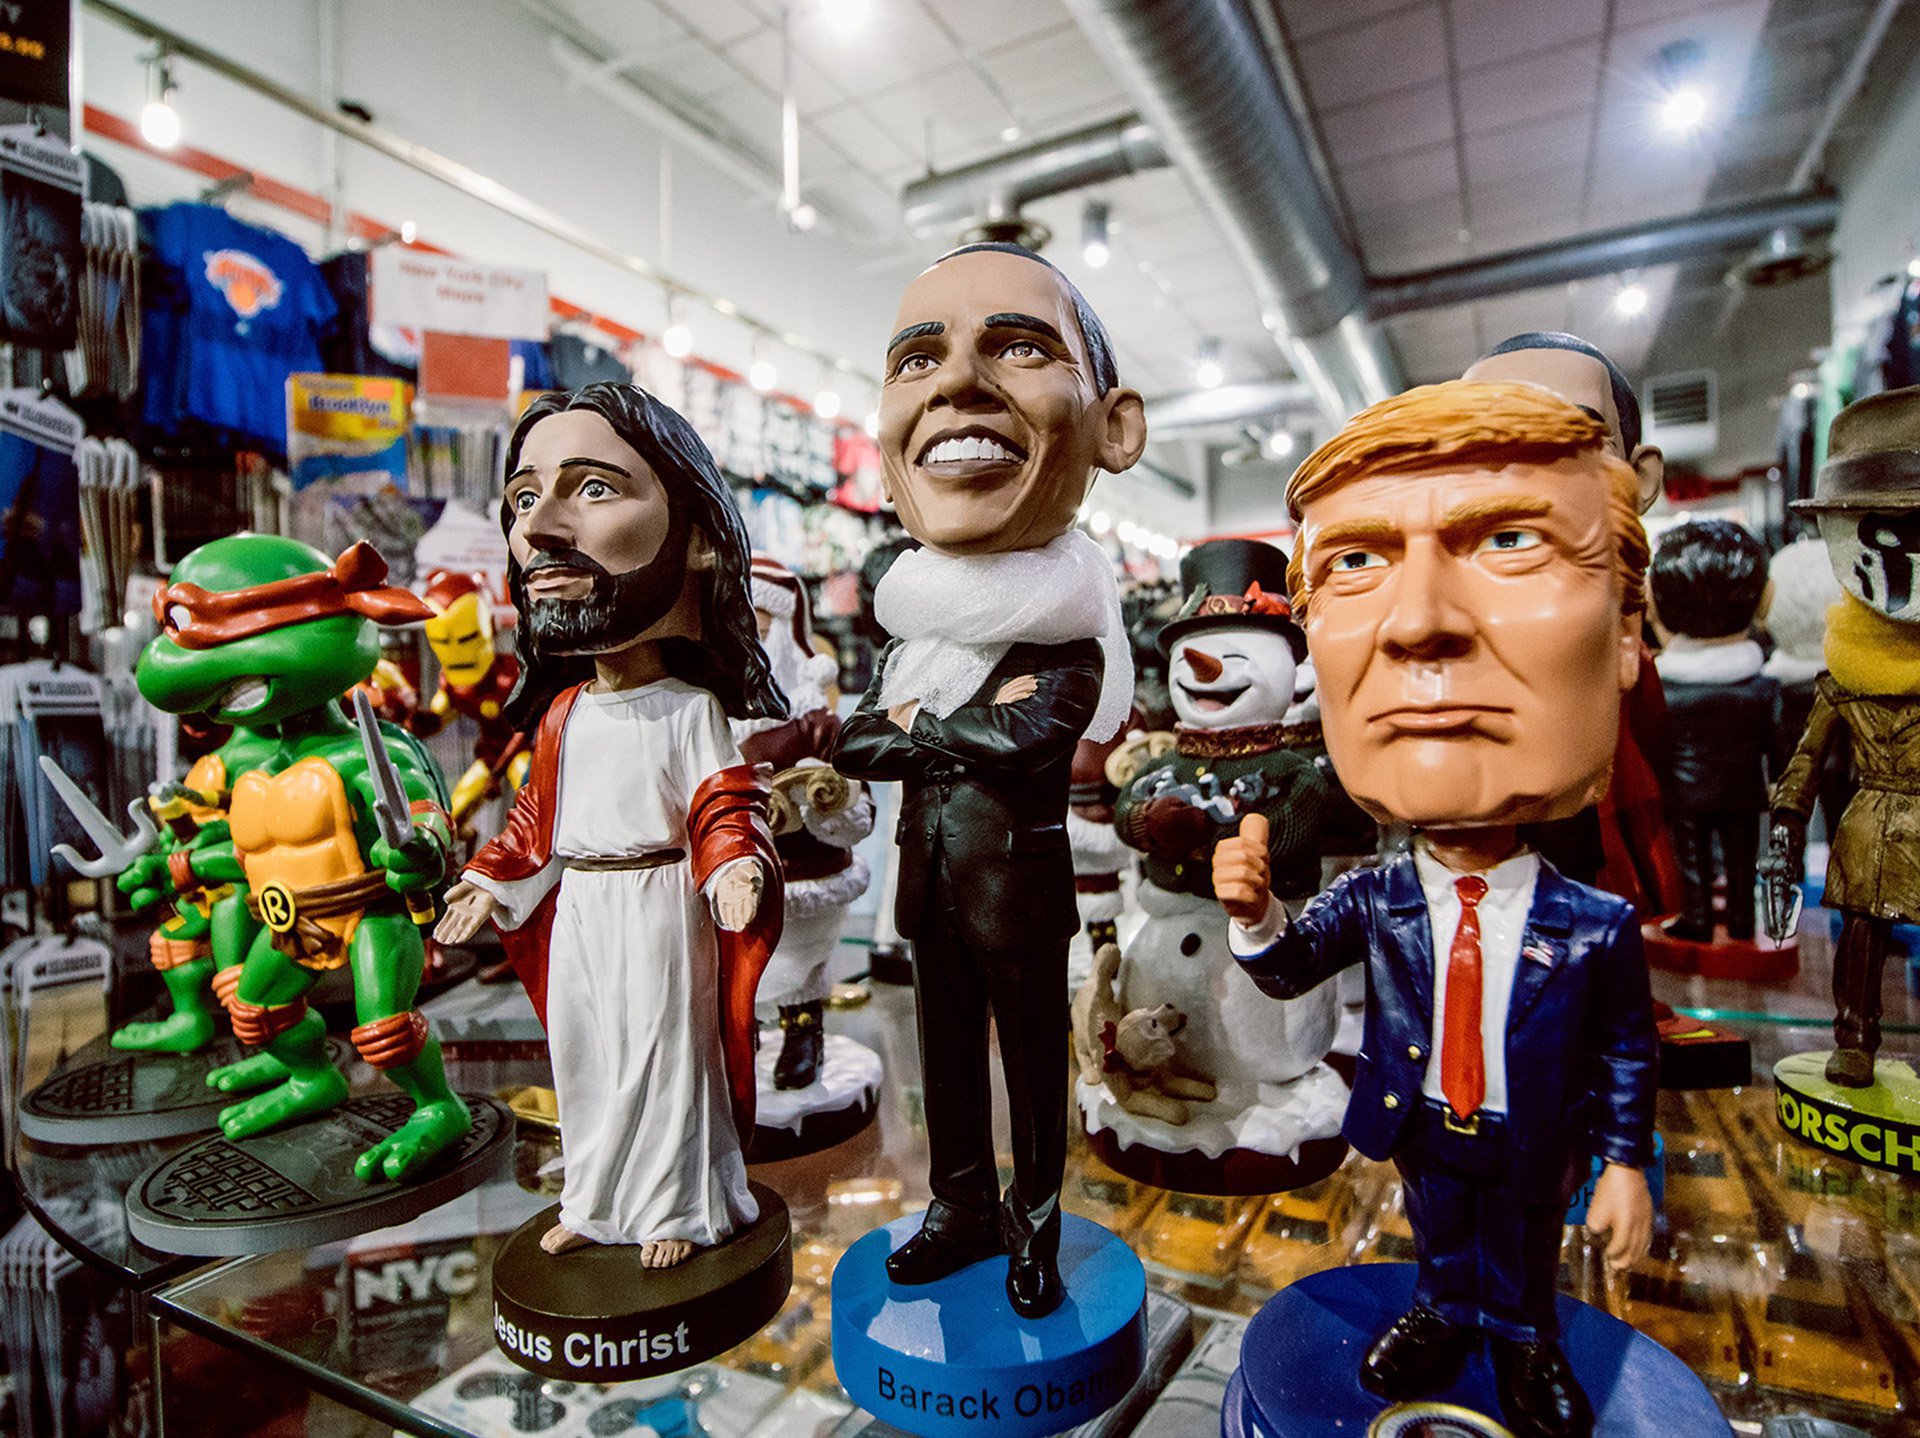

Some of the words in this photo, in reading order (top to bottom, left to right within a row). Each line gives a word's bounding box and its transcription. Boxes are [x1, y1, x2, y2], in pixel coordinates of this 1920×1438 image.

[309, 396, 391, 416] Brooklyn
[263, 889, 288, 924] R
[1776, 1086, 1920, 1172] ORSCH
[353, 1251, 478, 1310] NYC
[563, 1321, 690, 1367] Christ
[878, 1366, 1000, 1420] Barack
